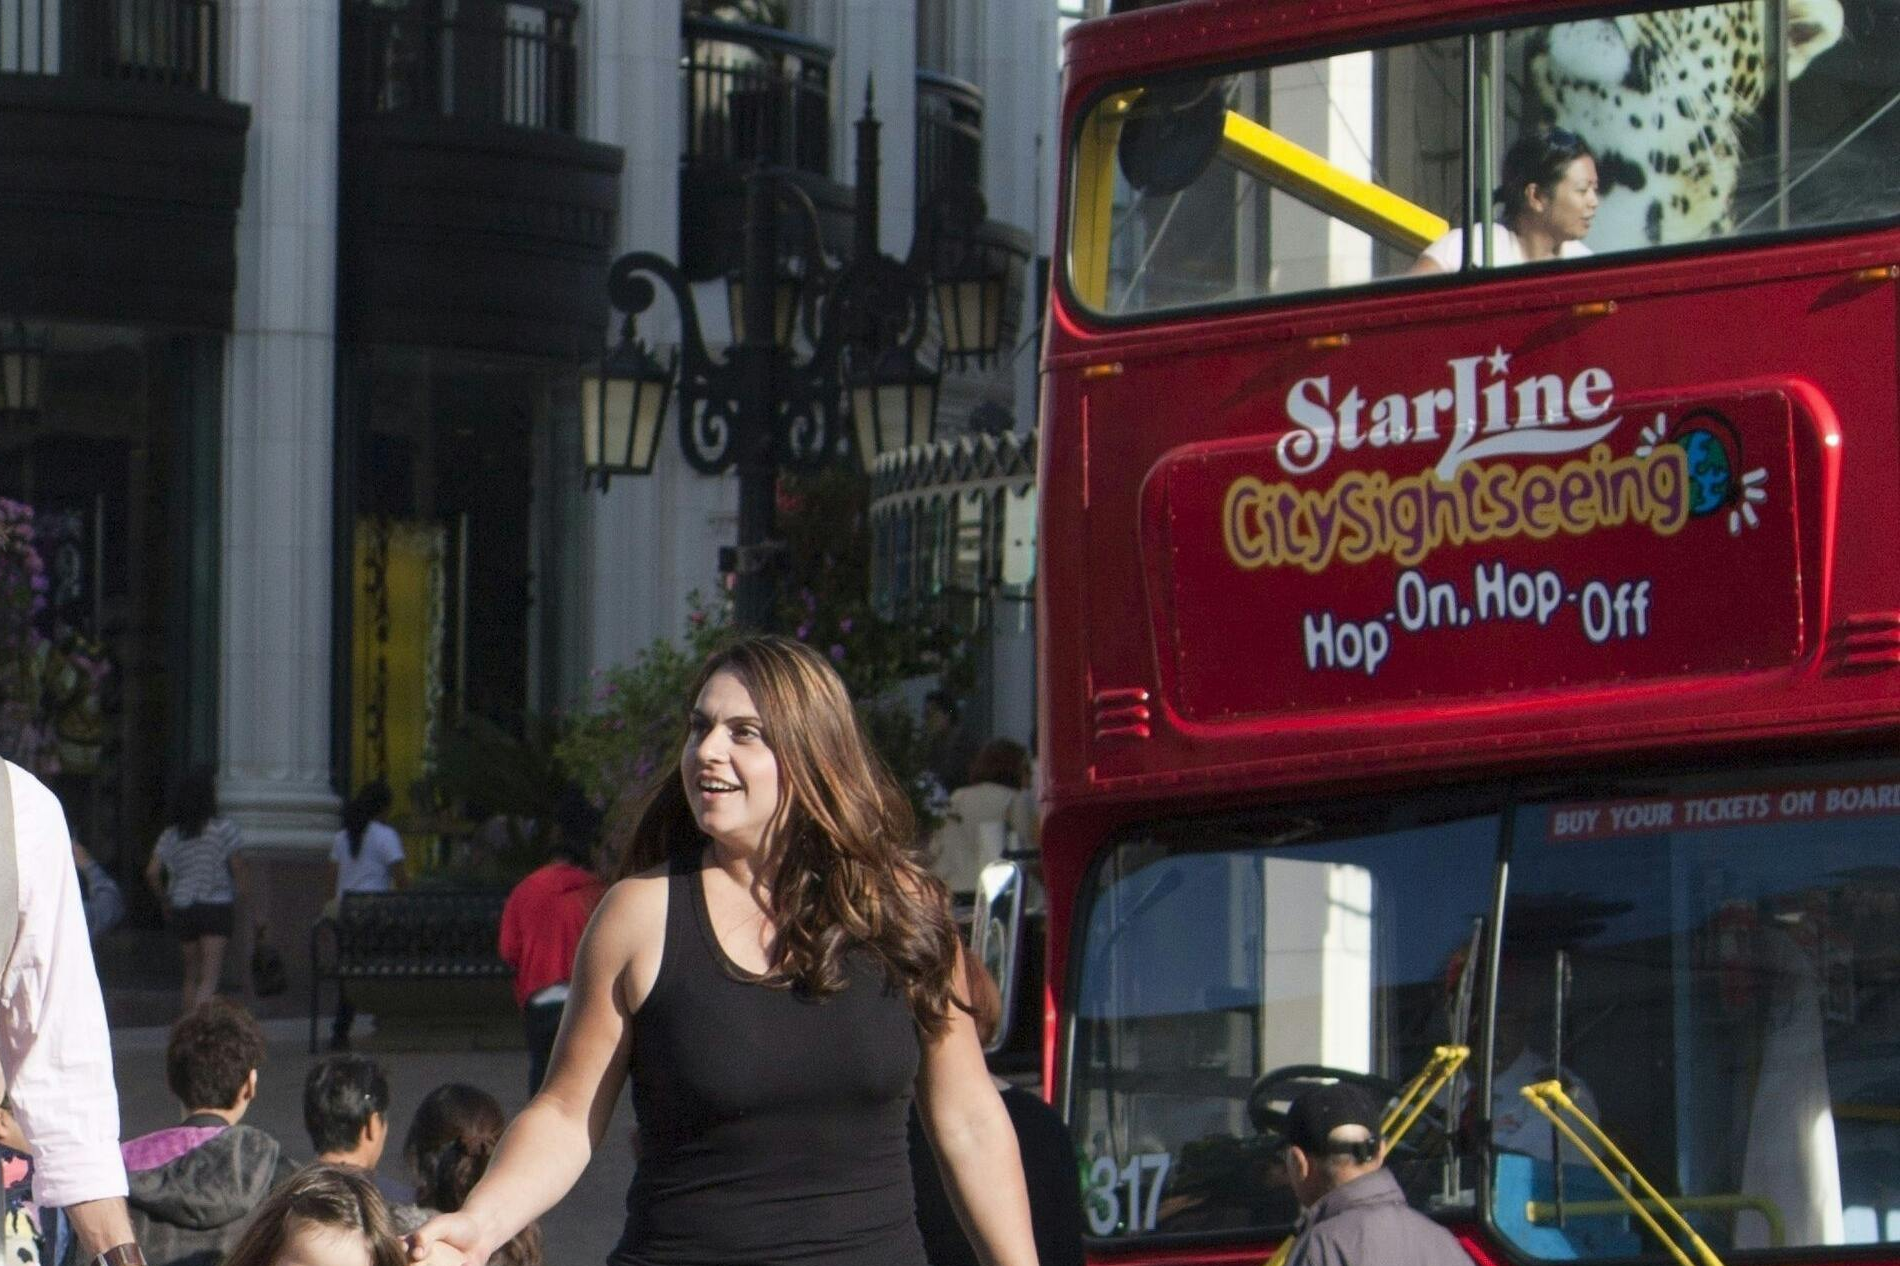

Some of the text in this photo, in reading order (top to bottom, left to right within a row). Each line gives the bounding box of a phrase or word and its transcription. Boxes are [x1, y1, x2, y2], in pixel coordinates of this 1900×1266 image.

[1554, 809, 1600, 836] BUY
[1609, 803, 1674, 831] YOUR
[1684, 793, 1771, 823] TICKETS
[1780, 791, 1817, 815] ON
[1086, 1152, 1171, 1236] 317
